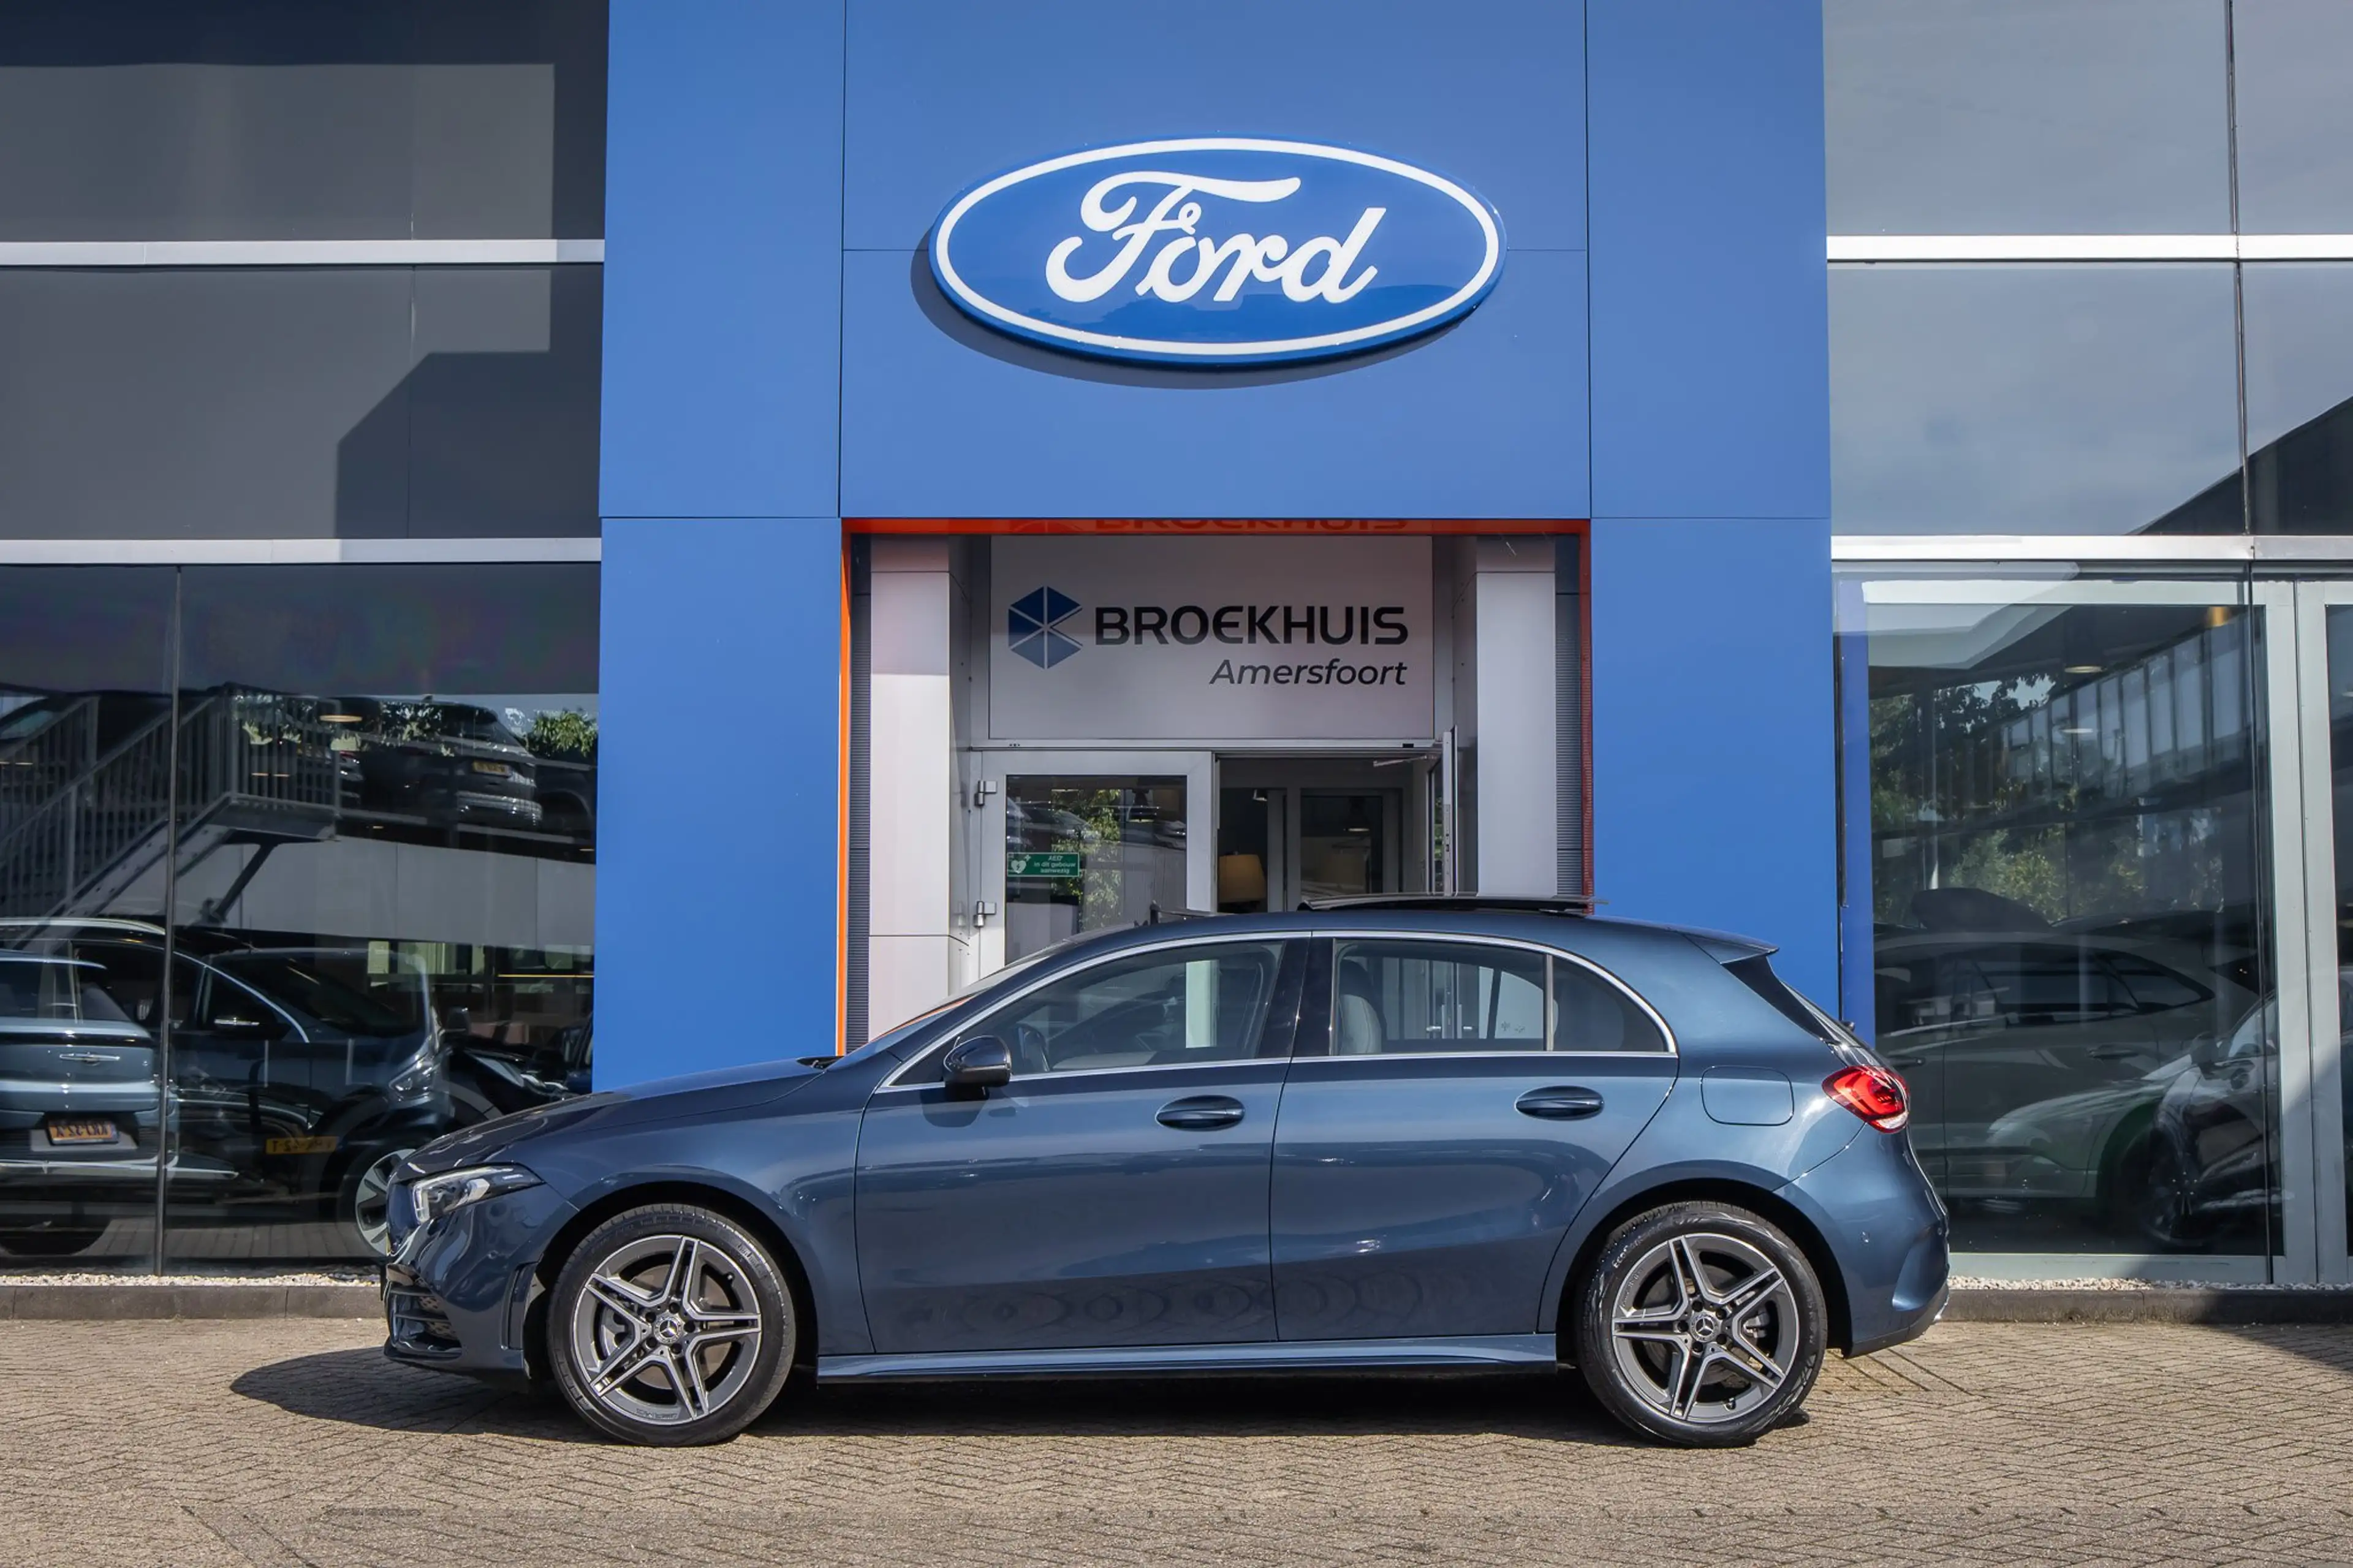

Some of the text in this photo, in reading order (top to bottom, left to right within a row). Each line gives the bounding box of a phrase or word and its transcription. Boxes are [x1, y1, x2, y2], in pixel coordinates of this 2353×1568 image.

[1045, 171, 1387, 303] Ford
[1095, 605, 1408, 645] BROEKHUIS
[1209, 658, 1408, 685] Amersfoort
